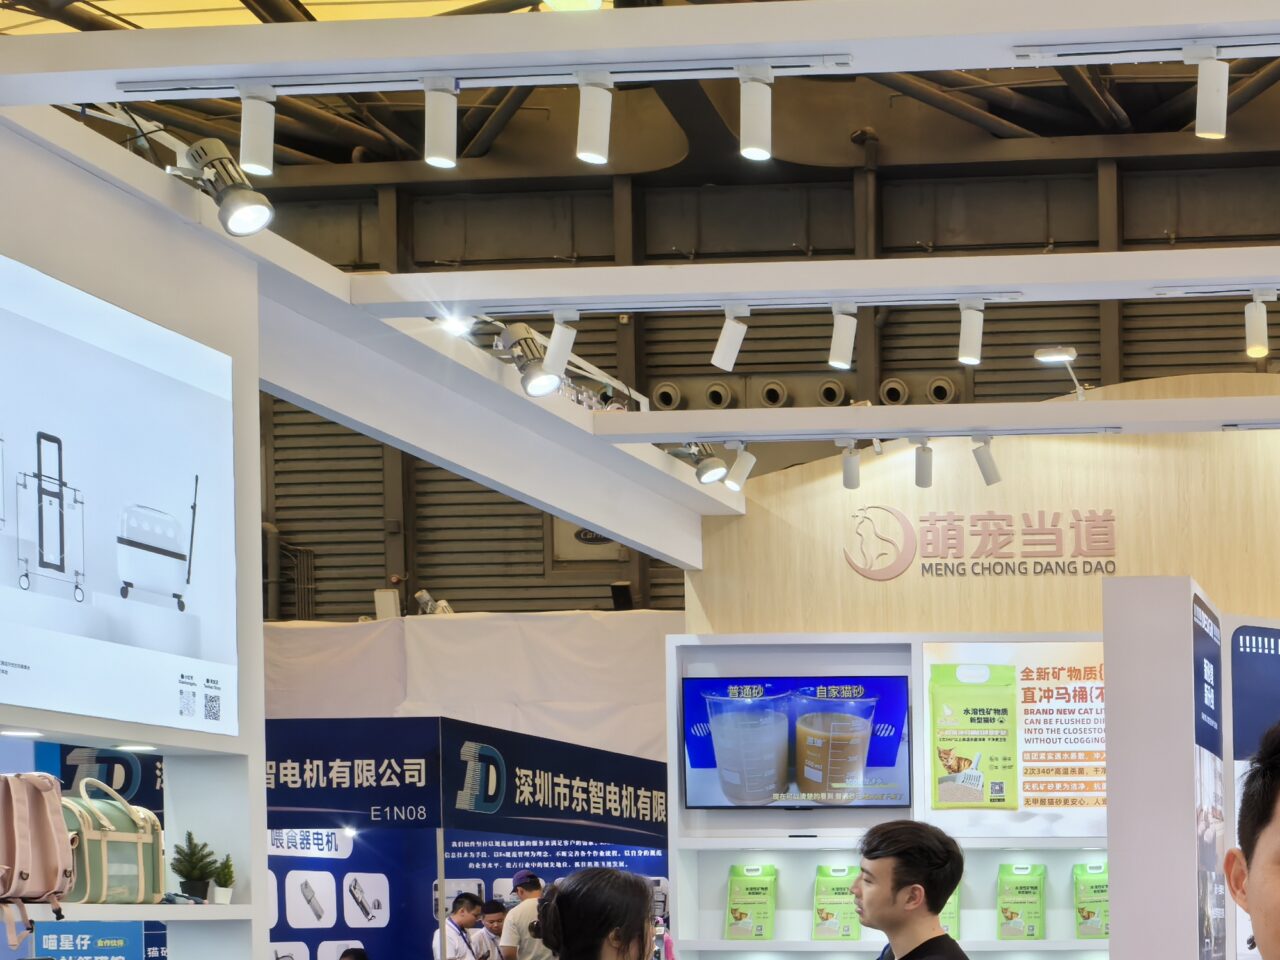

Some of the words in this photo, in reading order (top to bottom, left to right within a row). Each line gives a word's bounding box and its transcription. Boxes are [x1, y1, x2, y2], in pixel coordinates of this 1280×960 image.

[919, 508, 1117, 559] 萌宠当道
[921, 562, 967, 577] MENG
[971, 562, 1029, 576] CHONG
[1032, 561, 1079, 575] DANG
[1083, 560, 1117, 575] DAO
[727, 685, 764, 698] 普通砂
[816, 685, 866, 698] 自家猫砂
[515, 766, 667, 824] 深圳市东智电机有限
[371, 804, 426, 821] E1N08
[270, 829, 339, 852] 喂食器电机
[42, 934, 91, 950] 喵星仔
